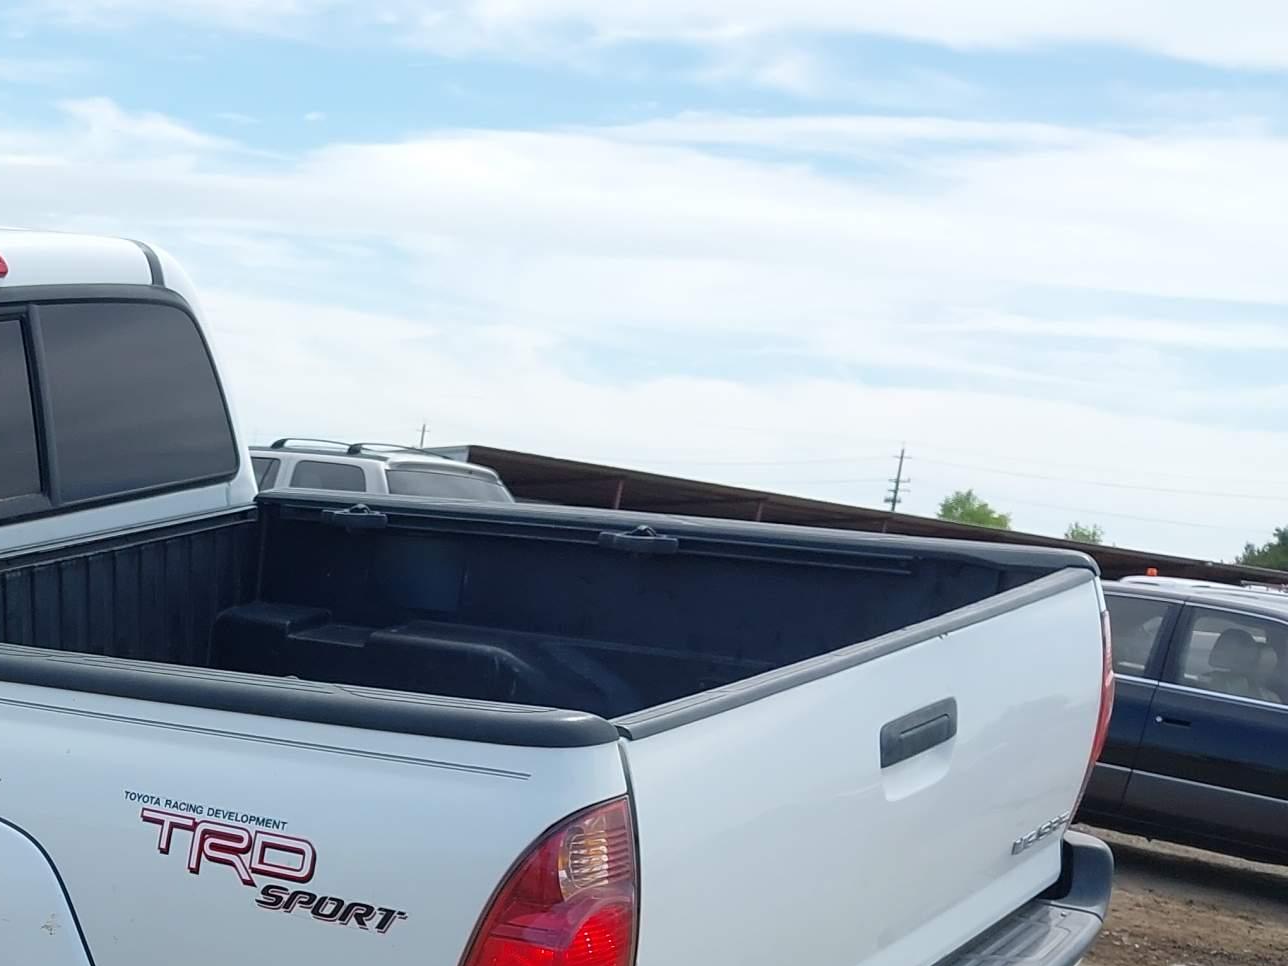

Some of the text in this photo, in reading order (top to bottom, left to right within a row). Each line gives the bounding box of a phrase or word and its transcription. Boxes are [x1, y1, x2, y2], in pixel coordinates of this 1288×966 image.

[124, 790, 288, 831] TOYOTA RACING DEVELOPMENT
[141, 807, 317, 888] TRD
[255, 884, 402, 934] SPORT
